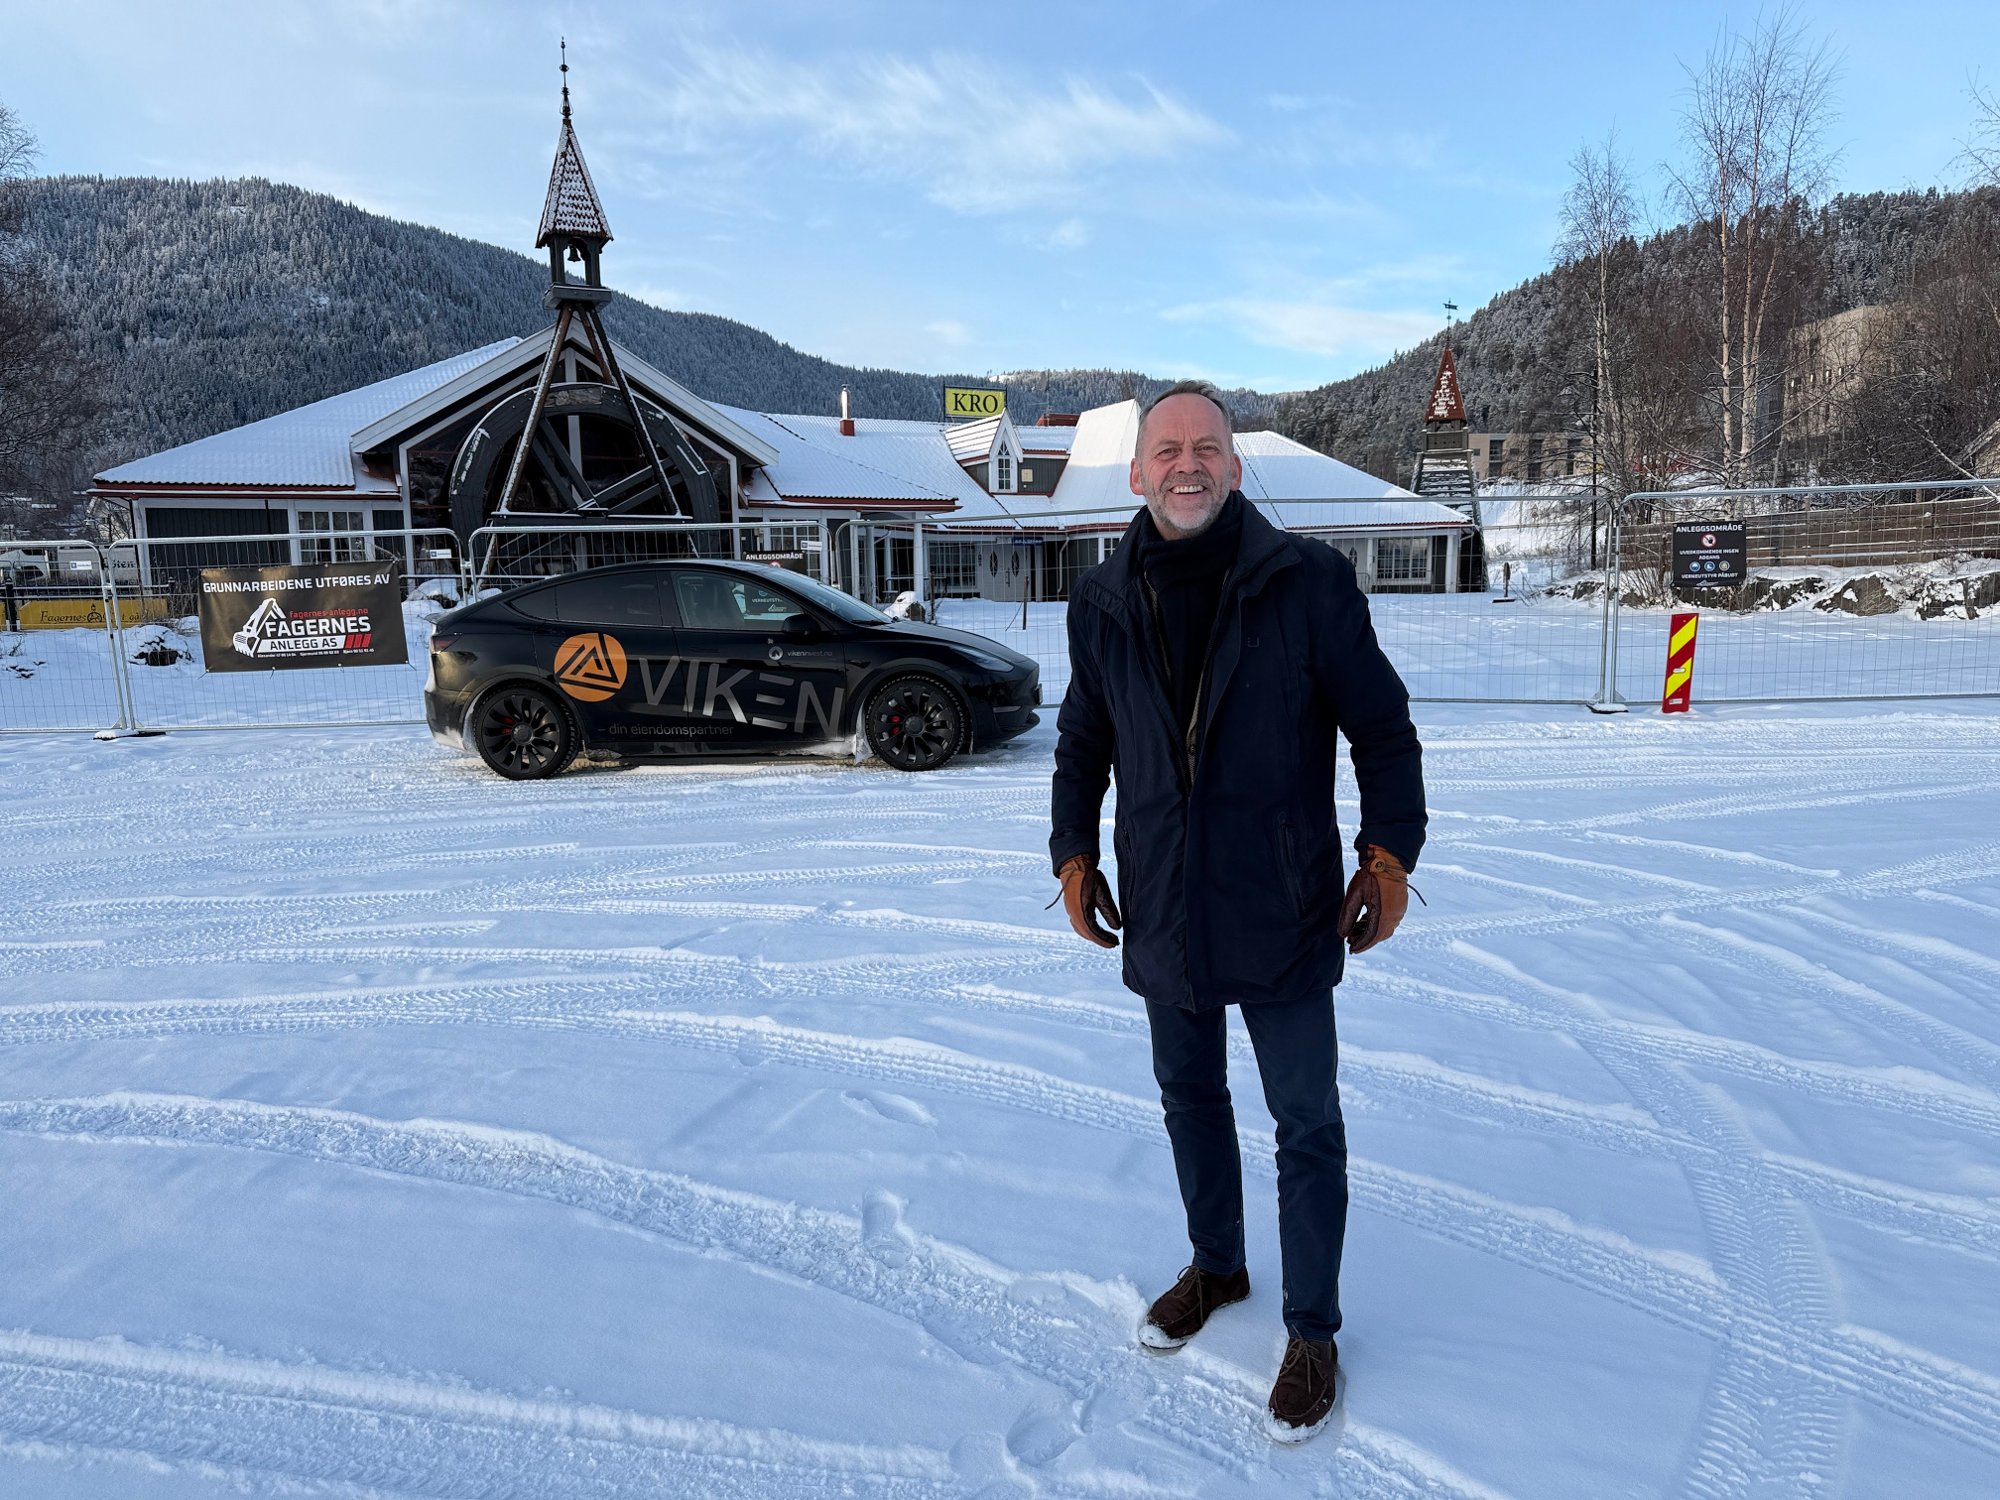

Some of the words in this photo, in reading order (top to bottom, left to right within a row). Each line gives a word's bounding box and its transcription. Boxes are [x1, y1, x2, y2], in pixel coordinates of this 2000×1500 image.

[953, 393, 998, 413] KRO
[1676, 523, 1743, 533] ANLEGGSOMRÅDE
[745, 552, 803, 561] ANLEGGSOMRÅDE
[203, 578, 313, 593] GRUNNARBEIDENE
[316, 575, 371, 588] UTFØRES
[374, 573, 390, 585] AV
[40, 611, 87, 623] Fagernes
[289, 607, 369, 620] fagernes-anlegg.no
[265, 616, 371, 637] FAGERNES
[270, 638, 319, 651] ANLEGG
[322, 637, 337, 648] AS
[639, 655, 845, 742] VIKEN
[609, 723, 628, 735] din
[631, 725, 736, 738] eiendomspartner
